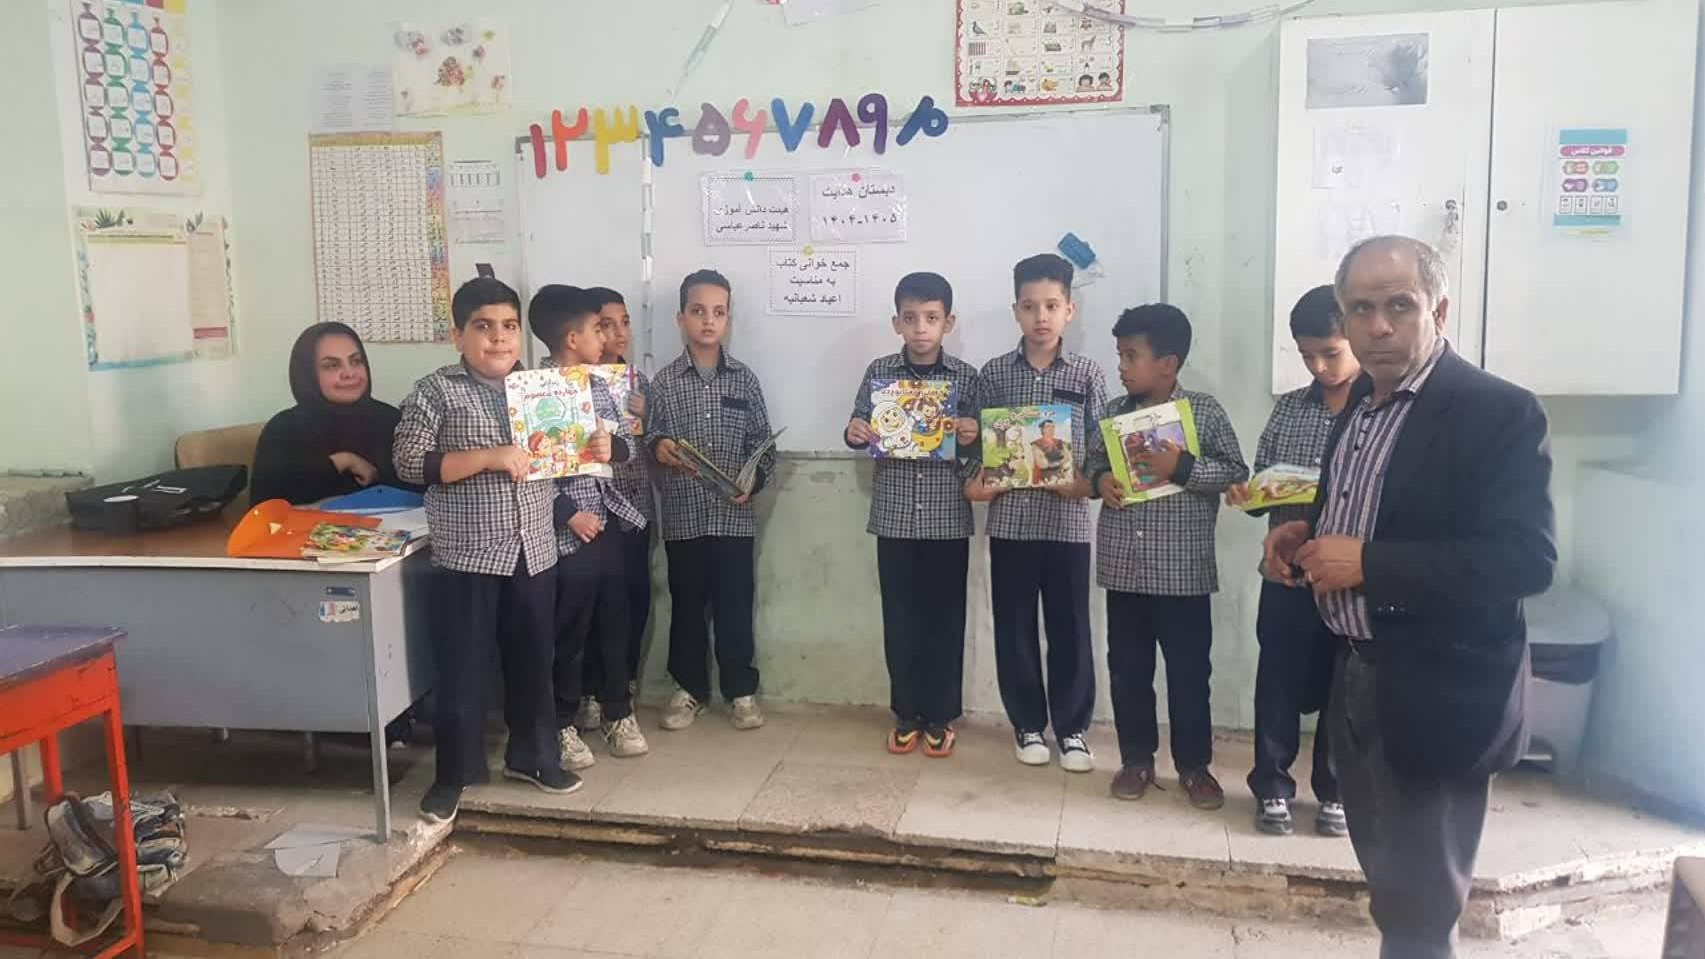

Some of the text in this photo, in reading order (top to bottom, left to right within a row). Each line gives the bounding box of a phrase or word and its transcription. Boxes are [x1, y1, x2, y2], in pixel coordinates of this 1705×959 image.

[822, 183, 896, 200] دبستان هدایت
[745, 203, 766, 215] دانش
[716, 219, 788, 233] شهید ناصر عباسی
[775, 258, 798, 269] کتاب
[830, 260, 850, 272] جمع
[789, 275, 836, 287] به مناسبت
[784, 292, 841, 305] اعیاد شعبانیه
